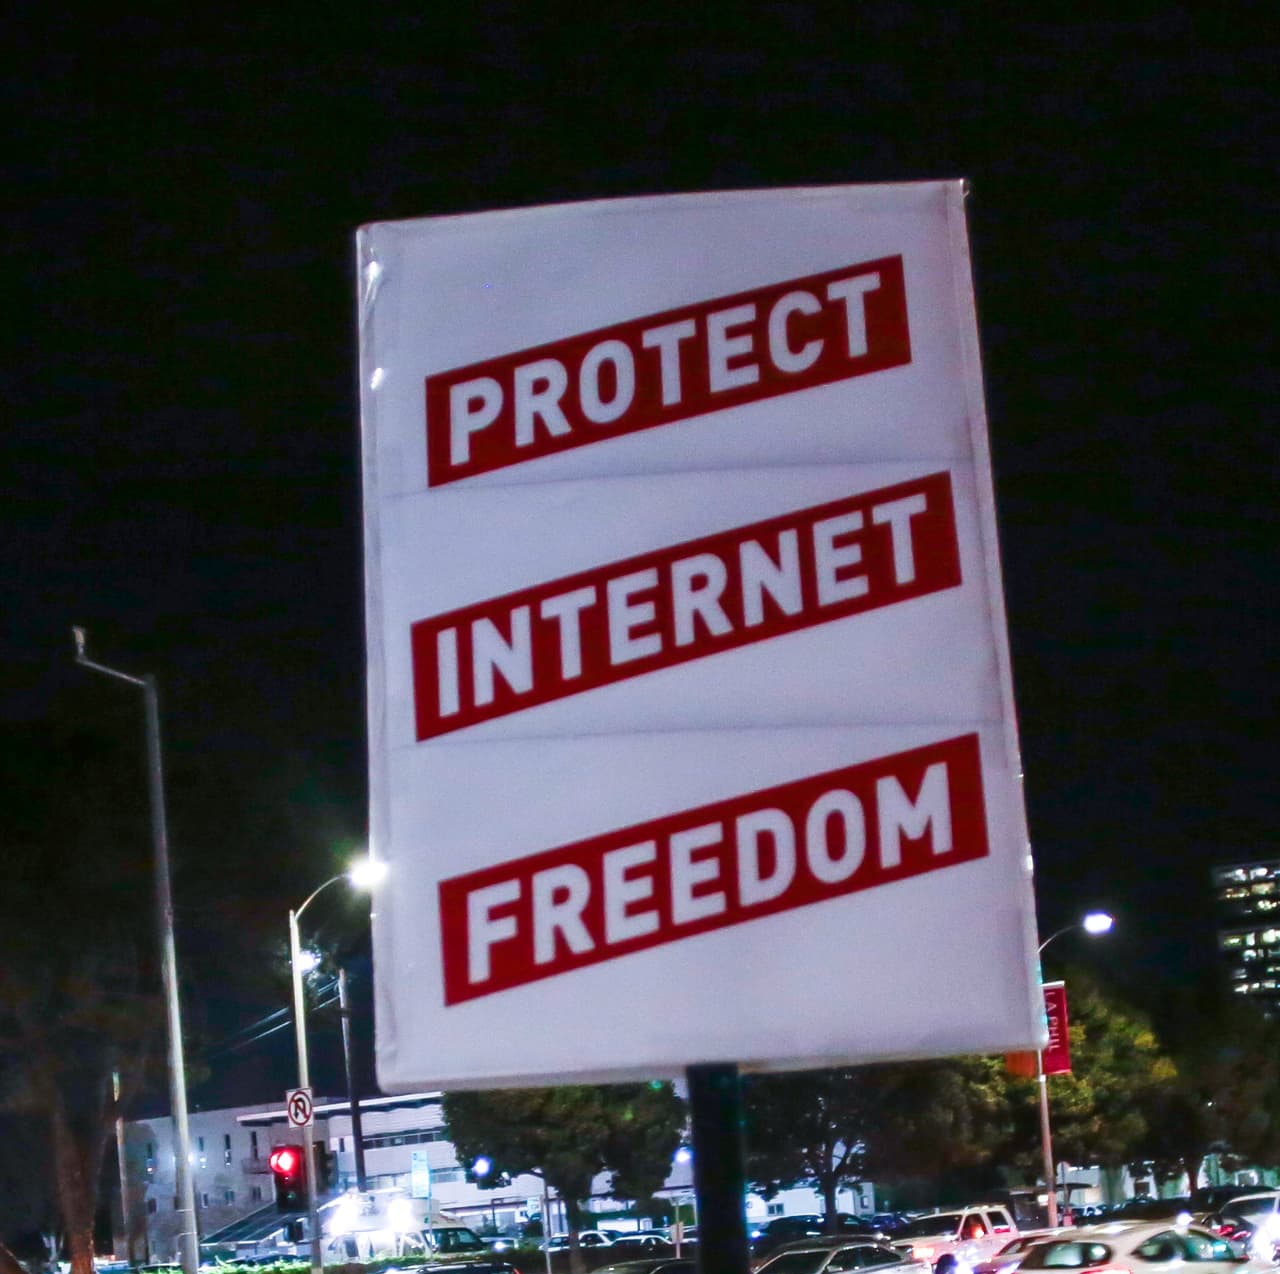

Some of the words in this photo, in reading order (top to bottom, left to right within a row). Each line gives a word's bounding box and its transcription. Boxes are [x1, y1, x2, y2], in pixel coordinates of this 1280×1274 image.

[449, 272, 881, 467] PROTECT
[436, 493, 927, 718] INTERNET
[466, 761, 953, 985] FREEDOM
[1048, 1016, 1061, 1053] PHIL
